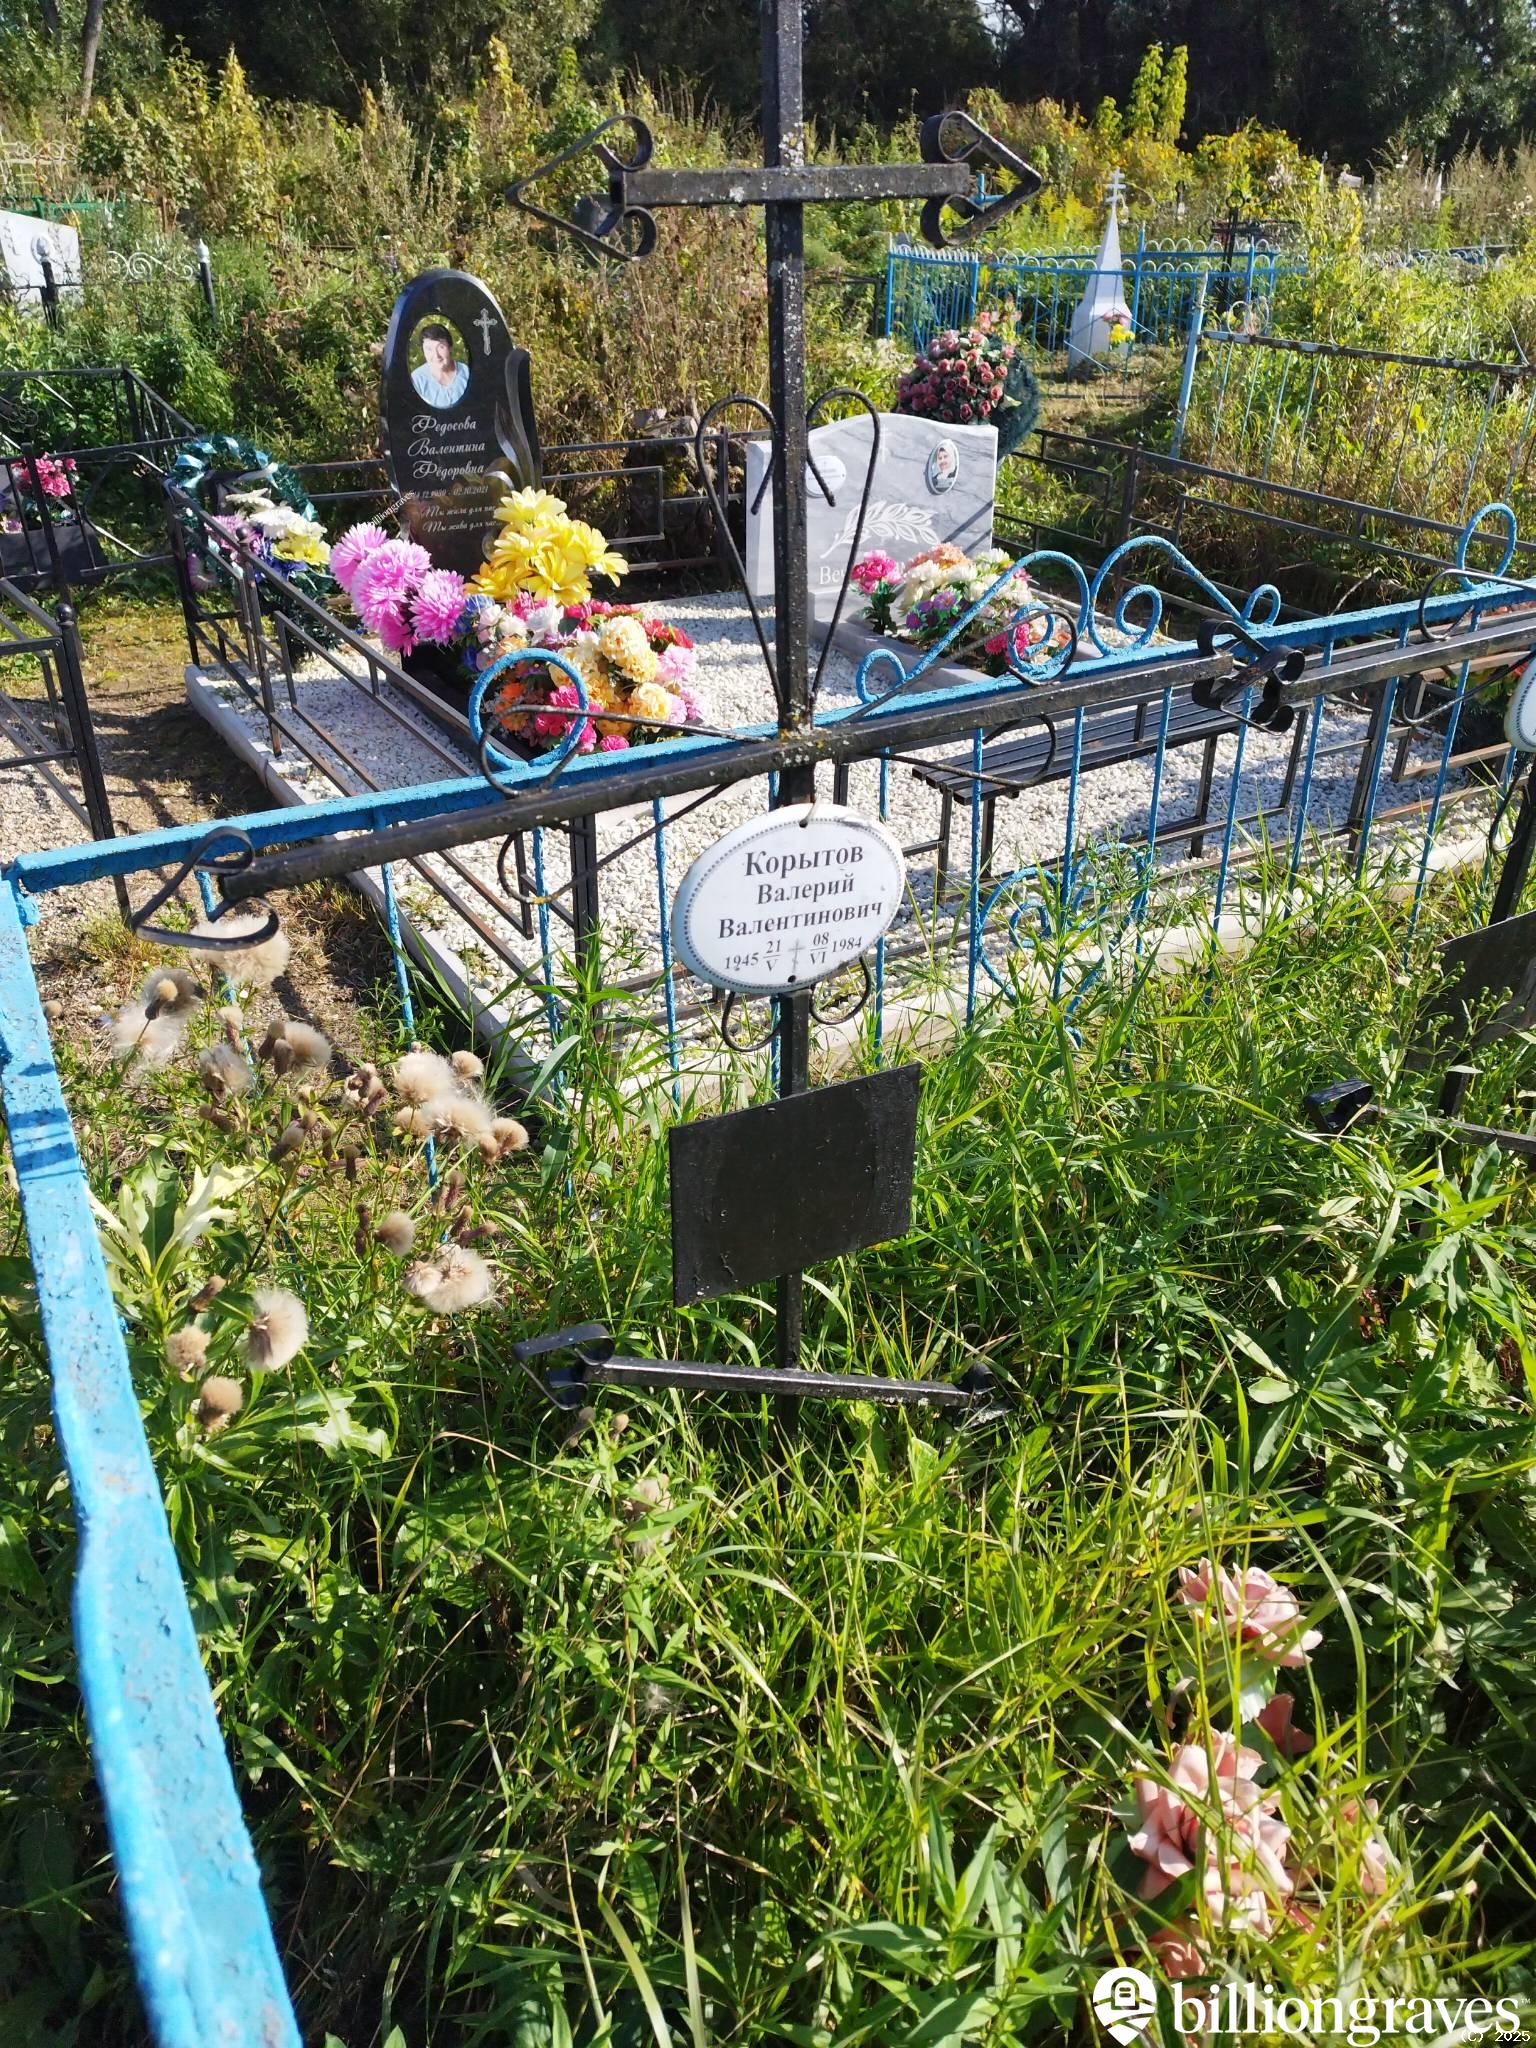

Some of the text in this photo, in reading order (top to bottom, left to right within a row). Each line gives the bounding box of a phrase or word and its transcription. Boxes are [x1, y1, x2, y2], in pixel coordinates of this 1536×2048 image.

[412, 414, 477, 436] Федосова
[407, 437, 486, 457] Валентина
[743, 845, 864, 879] Корытов
[757, 873, 855, 905] Валерий
[718, 901, 883, 939] Валентинович
[765, 939, 782, 954] 21
[812, 932, 830, 946] 08
[831, 936, 863, 953] 1984
[724, 952, 760, 971] 1945
[766, 958, 779, 972] V
[810, 951, 827, 965] VI
